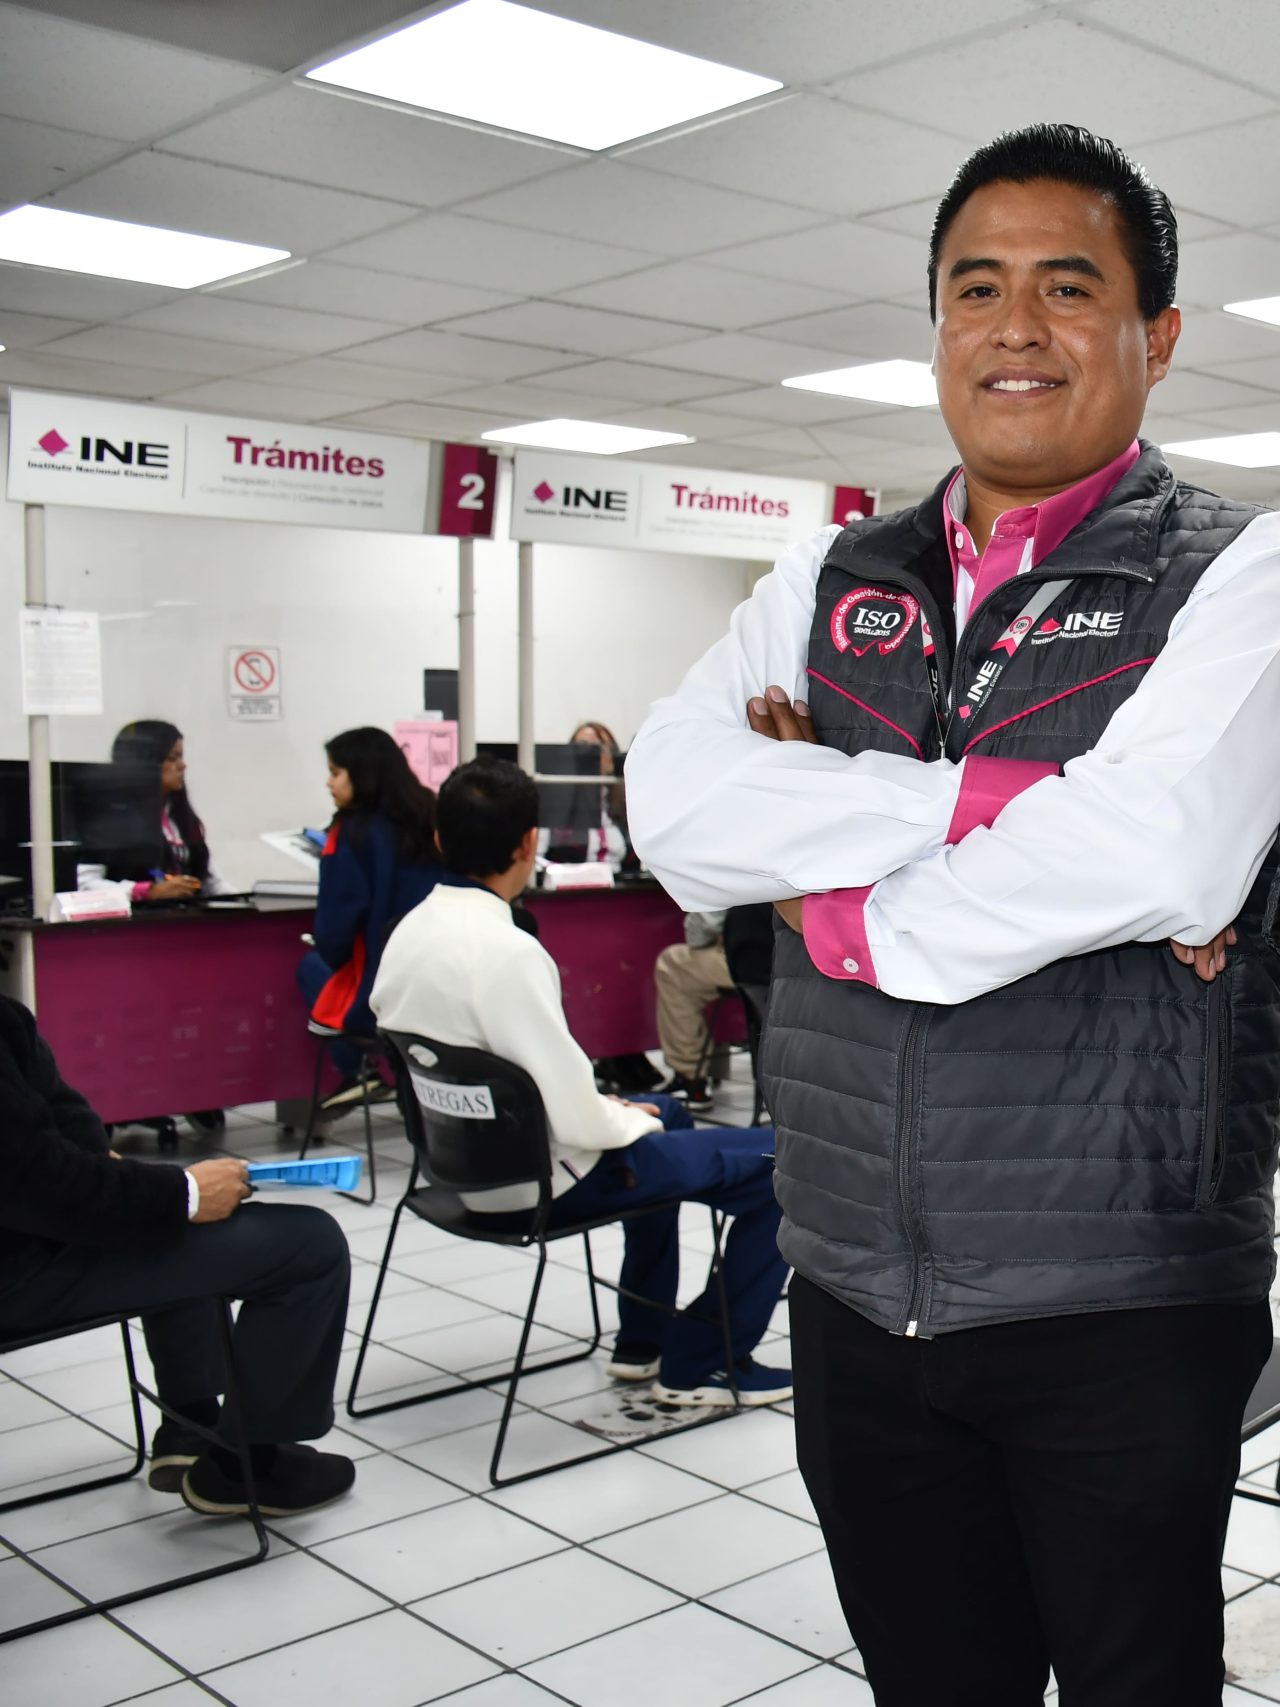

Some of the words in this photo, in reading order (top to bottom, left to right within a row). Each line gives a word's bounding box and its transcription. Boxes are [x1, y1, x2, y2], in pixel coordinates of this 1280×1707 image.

[81, 436, 169, 469] INE
[226, 435, 385, 479] Trámites
[76, 465, 121, 477] Nacional
[124, 470, 168, 481] Electoral
[457, 473, 486, 511] 2
[562, 486, 628, 513] INE
[671, 484, 790, 518] Trámites
[852, 607, 901, 629] ISO
[1063, 611, 1124, 631] INE
[967, 659, 998, 702] INE
